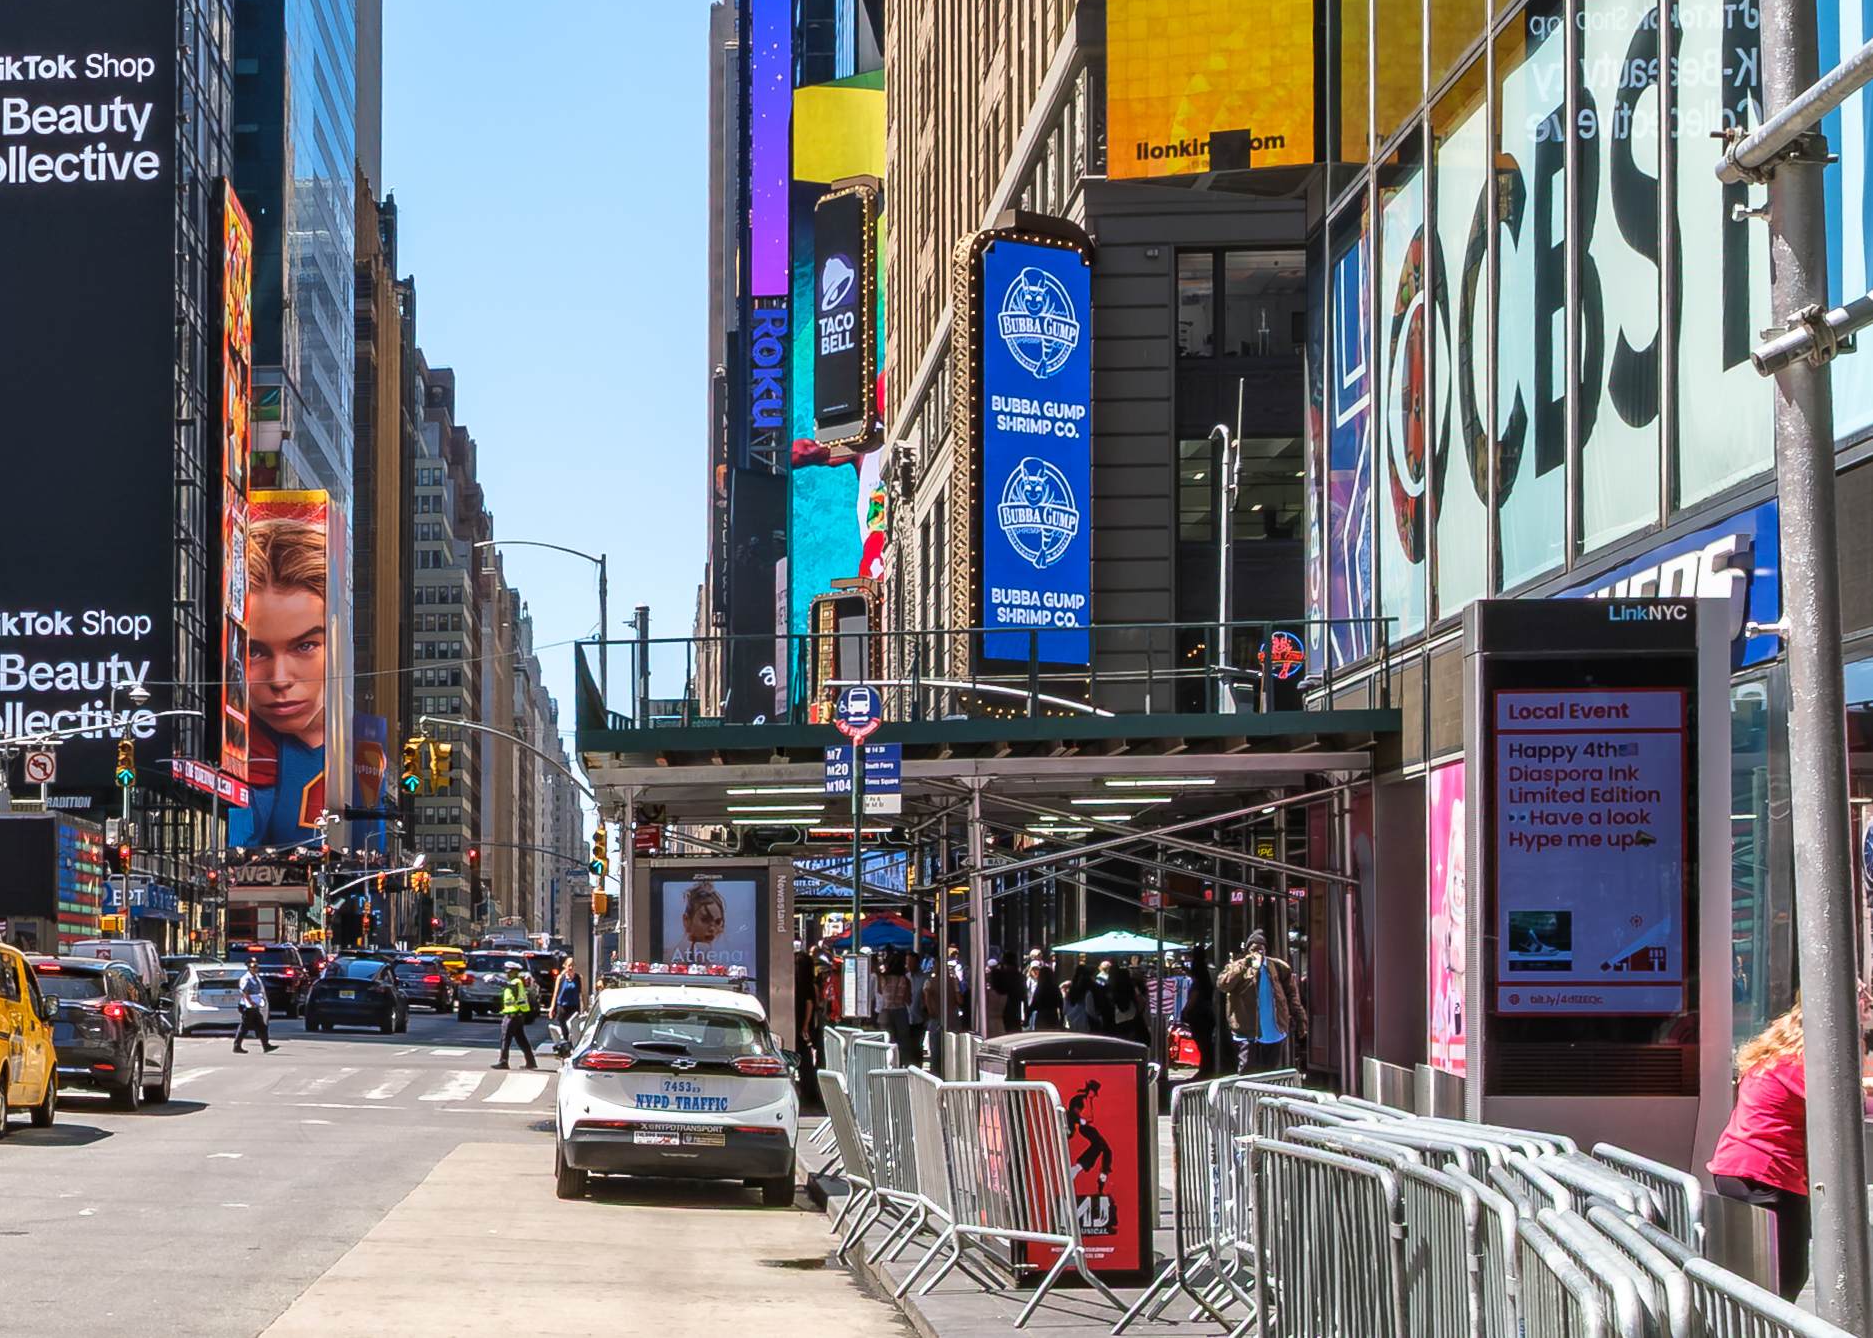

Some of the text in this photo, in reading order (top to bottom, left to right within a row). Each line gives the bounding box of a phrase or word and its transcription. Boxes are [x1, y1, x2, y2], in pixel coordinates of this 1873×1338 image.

[84, 52, 155, 82] Shop
[1136, 133, 1286, 161] lionkinom
[1460, 5, 1680, 508] CBS
[819, 312, 855, 335] TACO
[1002, 315, 1077, 342] BUBBA GUMP
[820, 332, 855, 356] BELL
[991, 395, 1085, 421] BUBBA GUMP
[996, 415, 1080, 439] SHRIMP CO.
[1002, 507, 1078, 533] BUBBA GUMP
[991, 587, 1085, 610] BUBBA GUMP
[81, 609, 153, 638] Shop
[996, 607, 1080, 628] SHRIMP CO.
[1609, 605, 1687, 622] LinkNYC
[1509, 702, 1630, 720] Local Event
[826, 748, 842, 761] M7
[1509, 742, 1618, 765] Happy 4th
[826, 763, 849, 776] M20
[1509, 766, 1639, 788] Diaspora Ink
[826, 779, 852, 793] M104
[1509, 786, 1661, 804] Limited Edition
[46, 796, 92, 808] RADITION
[1530, 809, 1651, 826] Have a look
[1509, 831, 1638, 853] Hype me up
[636, 1093, 728, 1111] NYPD TRAFFIC
